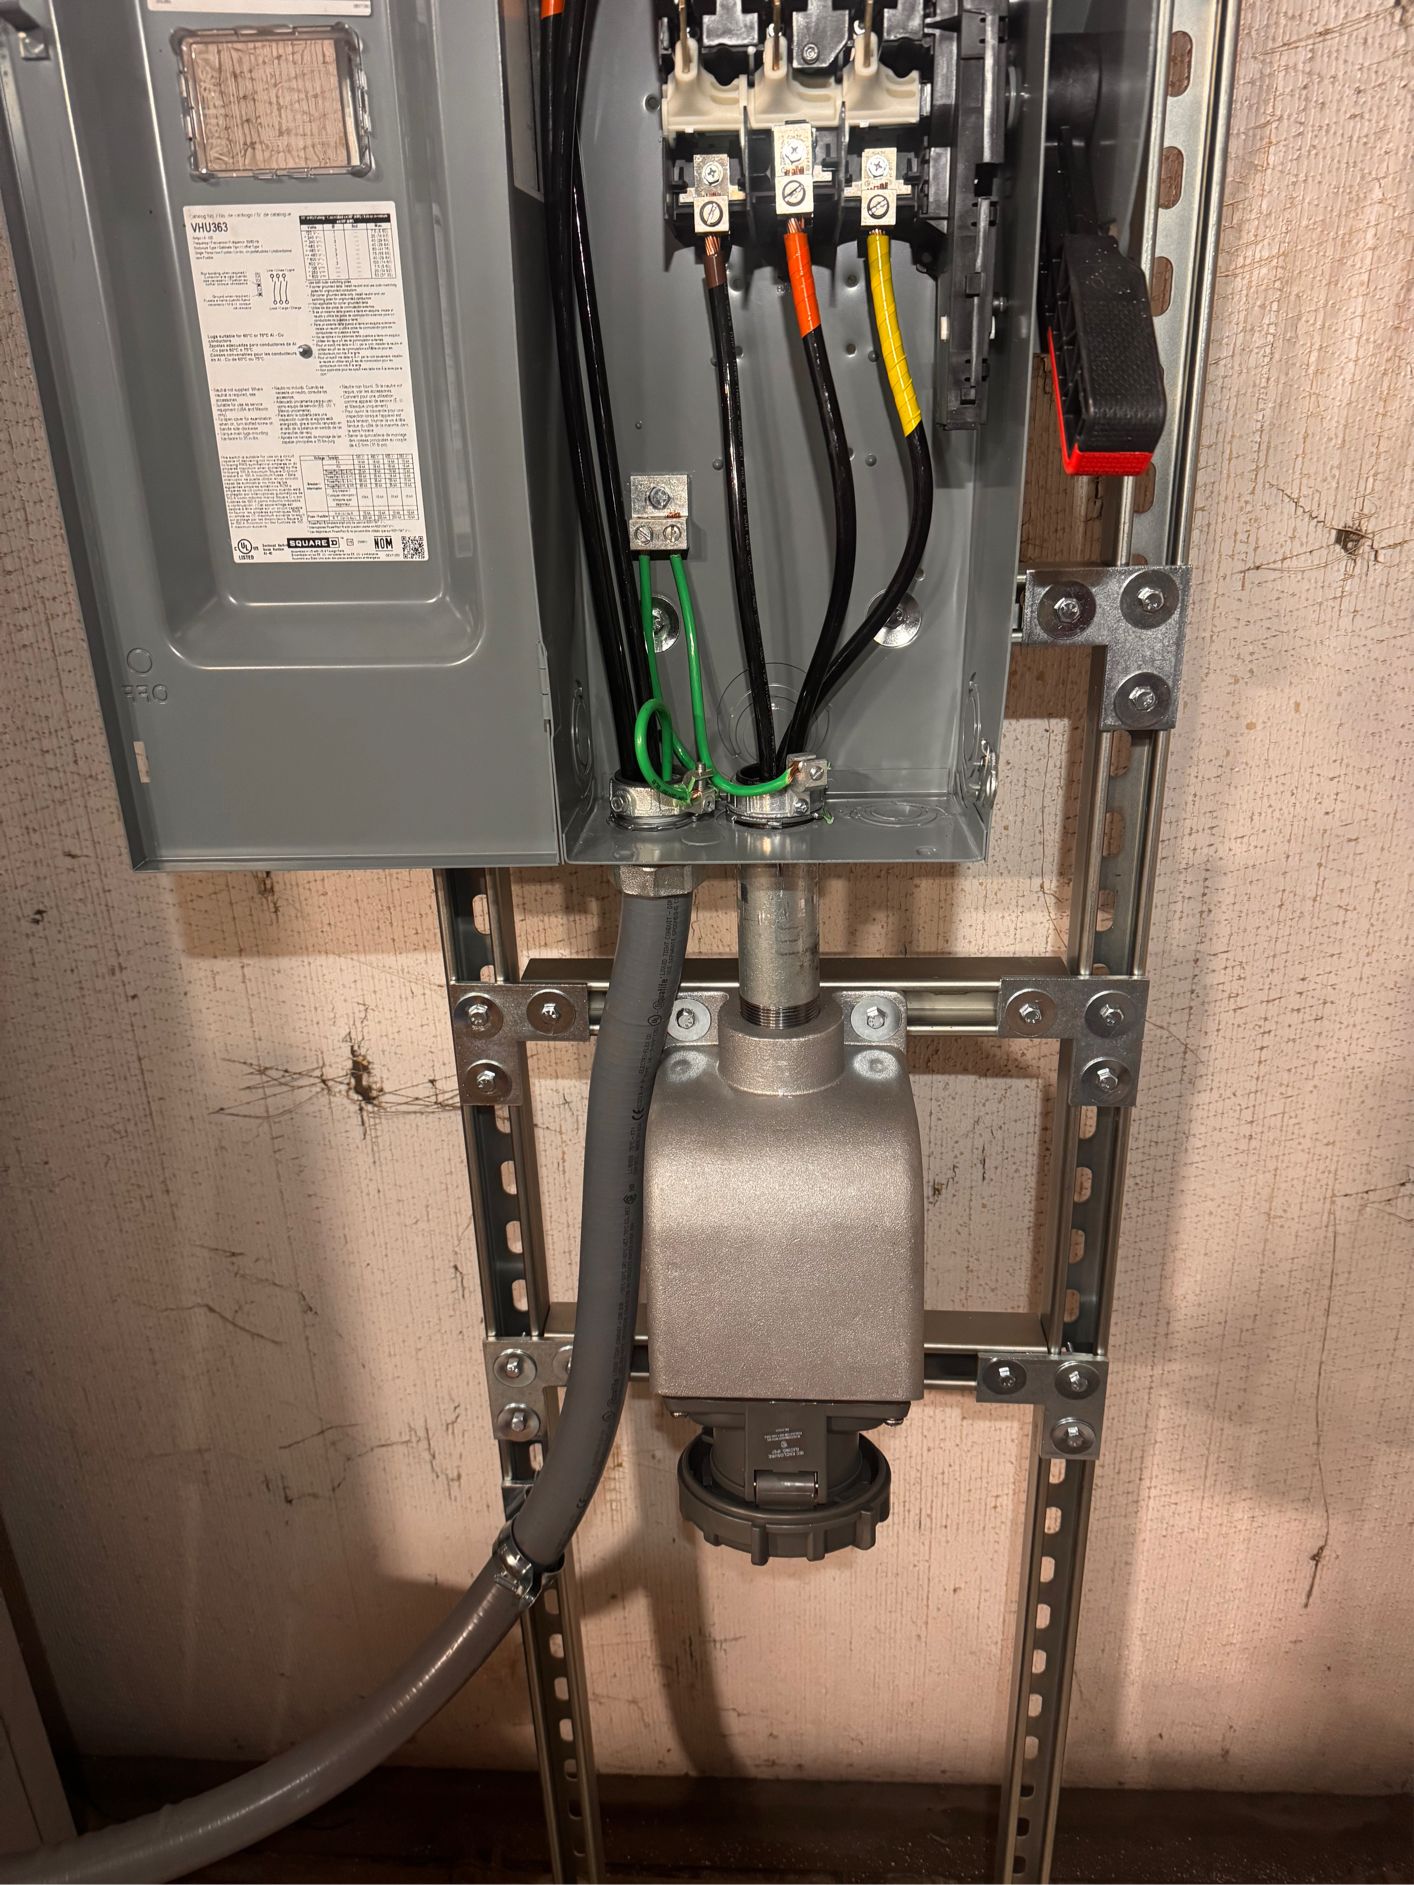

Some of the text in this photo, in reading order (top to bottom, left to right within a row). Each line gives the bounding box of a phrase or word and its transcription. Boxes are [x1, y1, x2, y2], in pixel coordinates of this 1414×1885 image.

[191, 222, 228, 232] VHU363
[374, 537, 393, 550] NOM
[631, 1108, 644, 1120] CE
